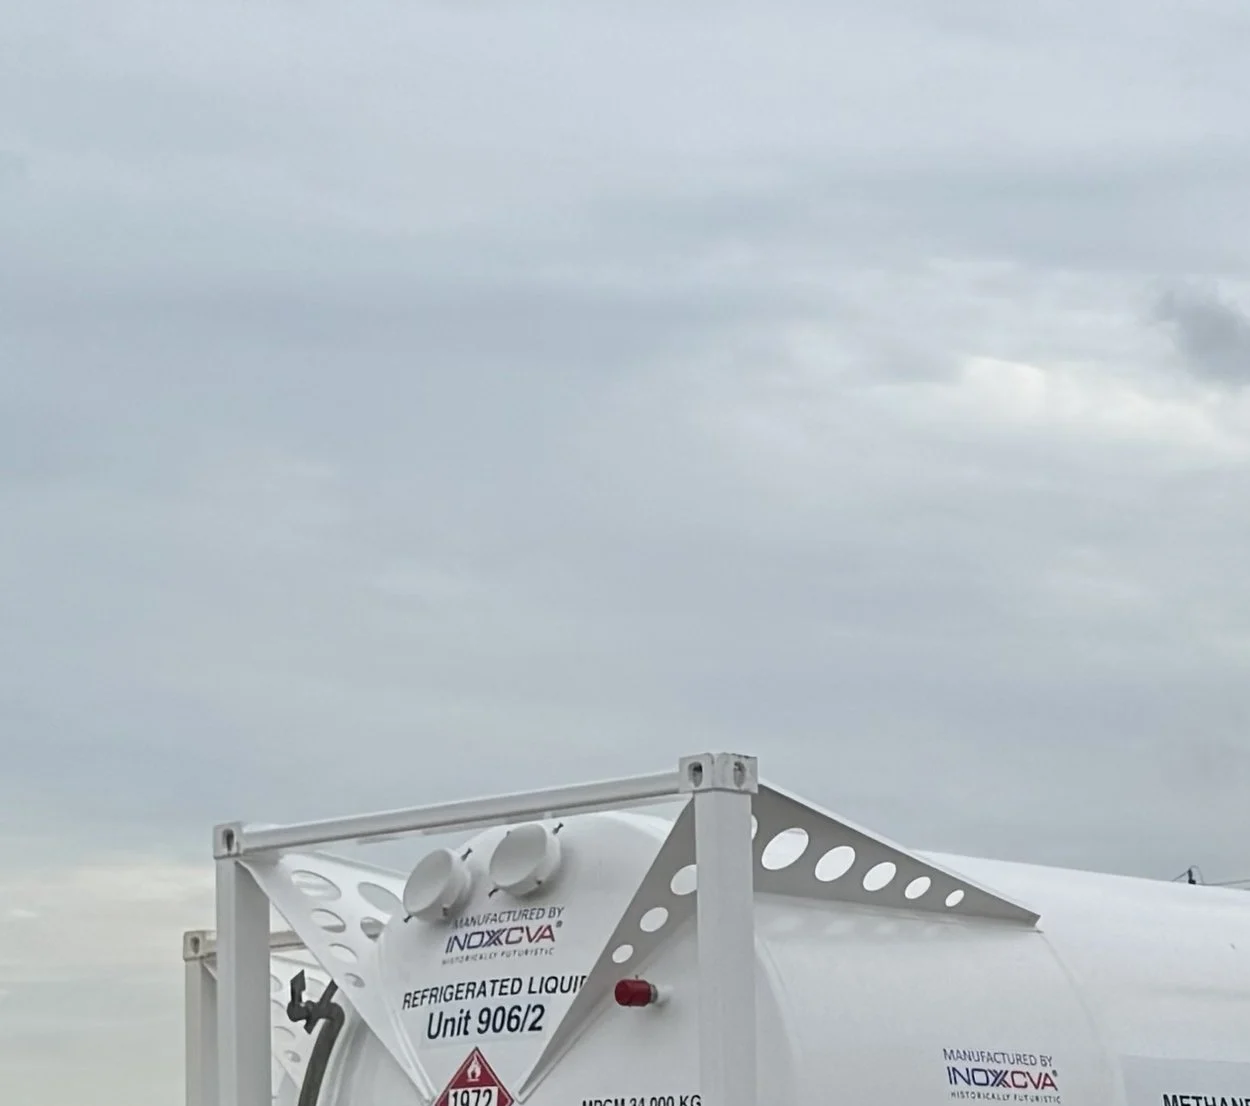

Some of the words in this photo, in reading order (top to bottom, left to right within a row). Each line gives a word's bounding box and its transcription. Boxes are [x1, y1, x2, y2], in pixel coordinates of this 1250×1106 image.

[454, 907, 545, 929] MANUFACTURED
[548, 906, 565, 919] BY
[402, 977, 523, 1010] REFRIGERATED
[427, 1007, 472, 1040] Unit
[476, 1004, 545, 1035] 906/2
[943, 1048, 1038, 1067] MANUFACTURED
[1039, 1055, 1053, 1067] BY
